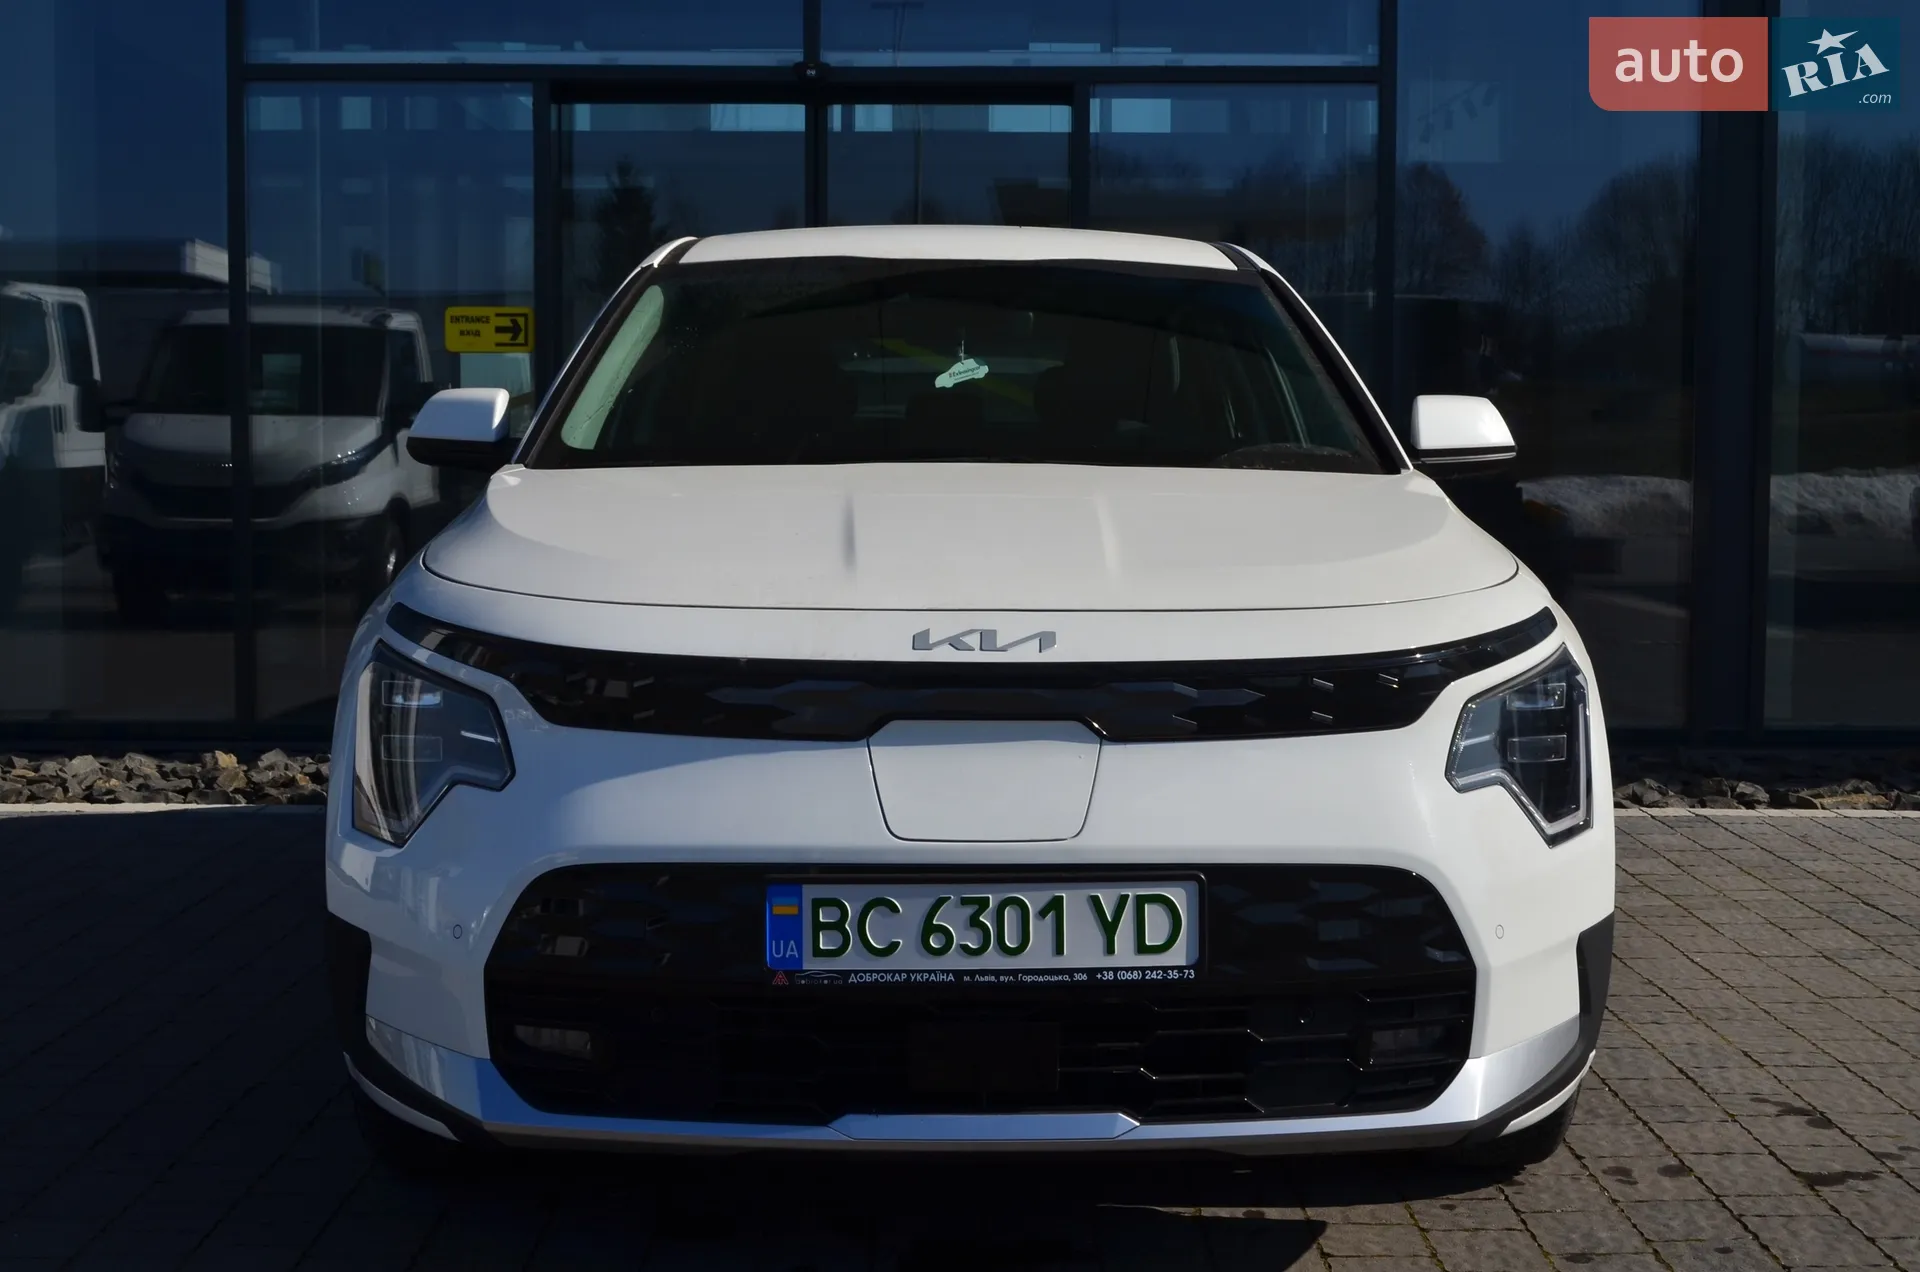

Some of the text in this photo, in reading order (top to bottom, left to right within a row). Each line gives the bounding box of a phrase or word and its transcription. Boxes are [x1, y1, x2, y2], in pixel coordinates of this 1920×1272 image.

[450, 315, 491, 324] ENTRANCE
[912, 628, 1057, 653] KIA
[811, 892, 1183, 958] BC 6301 YD
[771, 939, 799, 959] UA
[848, 973, 907, 983] ДОБРОКАР
[910, 971, 955, 982] УКРАЇНА
[974, 973, 998, 983] Львів,
[999, 975, 1017, 983] вул.
[1018, 973, 1071, 983] Городоцька,
[1073, 972, 1088, 981] 306
[1096, 972, 1114, 981] +38
[1117, 970, 1142, 981] (068)
[1145, 969, 1195, 980] 242-35-73
